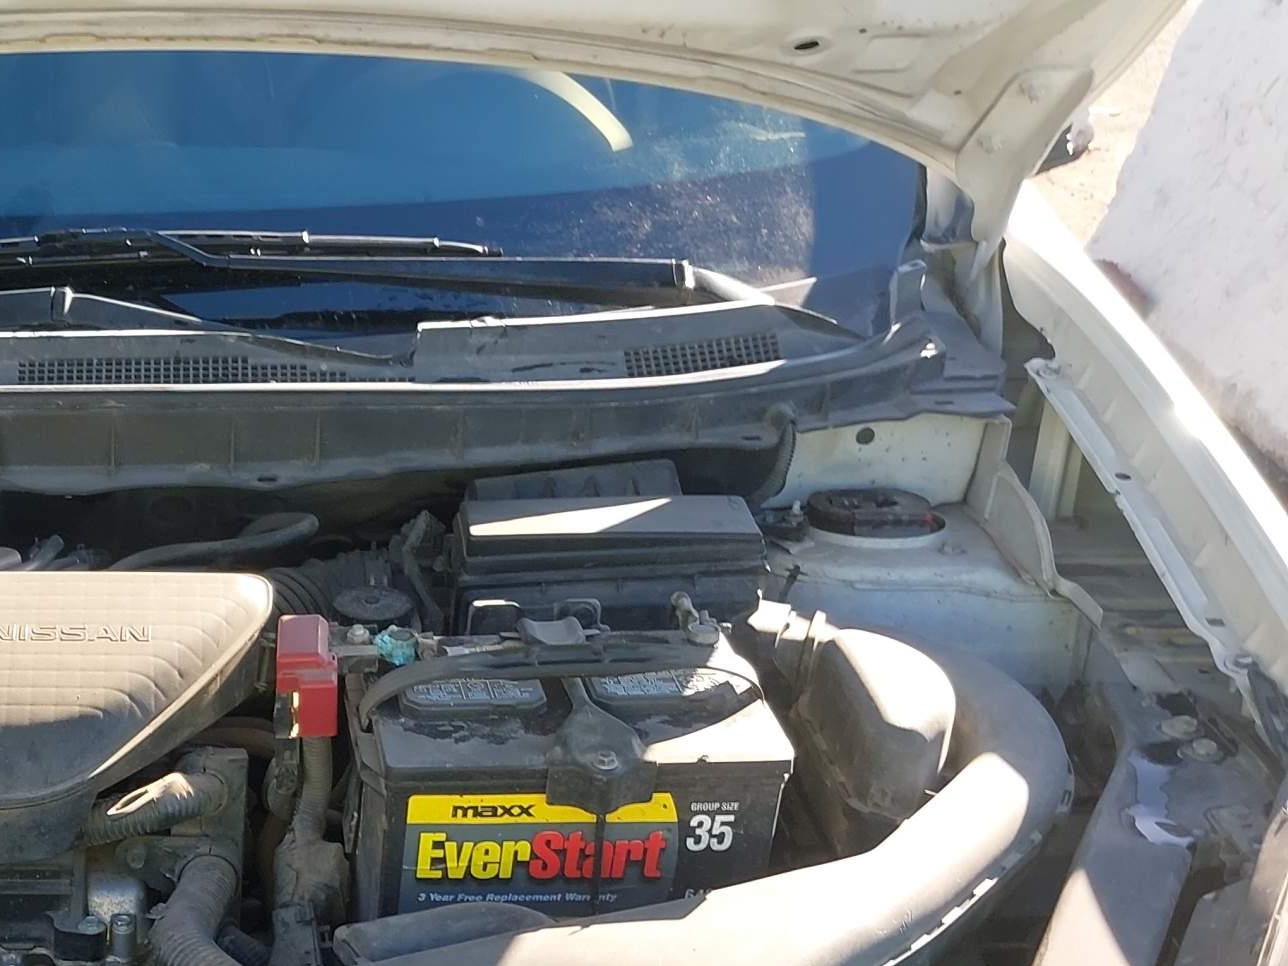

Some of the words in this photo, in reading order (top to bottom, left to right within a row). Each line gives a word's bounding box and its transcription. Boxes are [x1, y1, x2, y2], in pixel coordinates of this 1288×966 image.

[451, 803, 535, 818] maxx
[691, 802, 720, 811] GROUP
[721, 802, 740, 811] SIZE
[686, 814, 735, 851] 35
[417, 893, 427, 902] 3
[429, 893, 454, 902] Year
[457, 893, 482, 902] Free
[485, 893, 561, 903] Replacement
